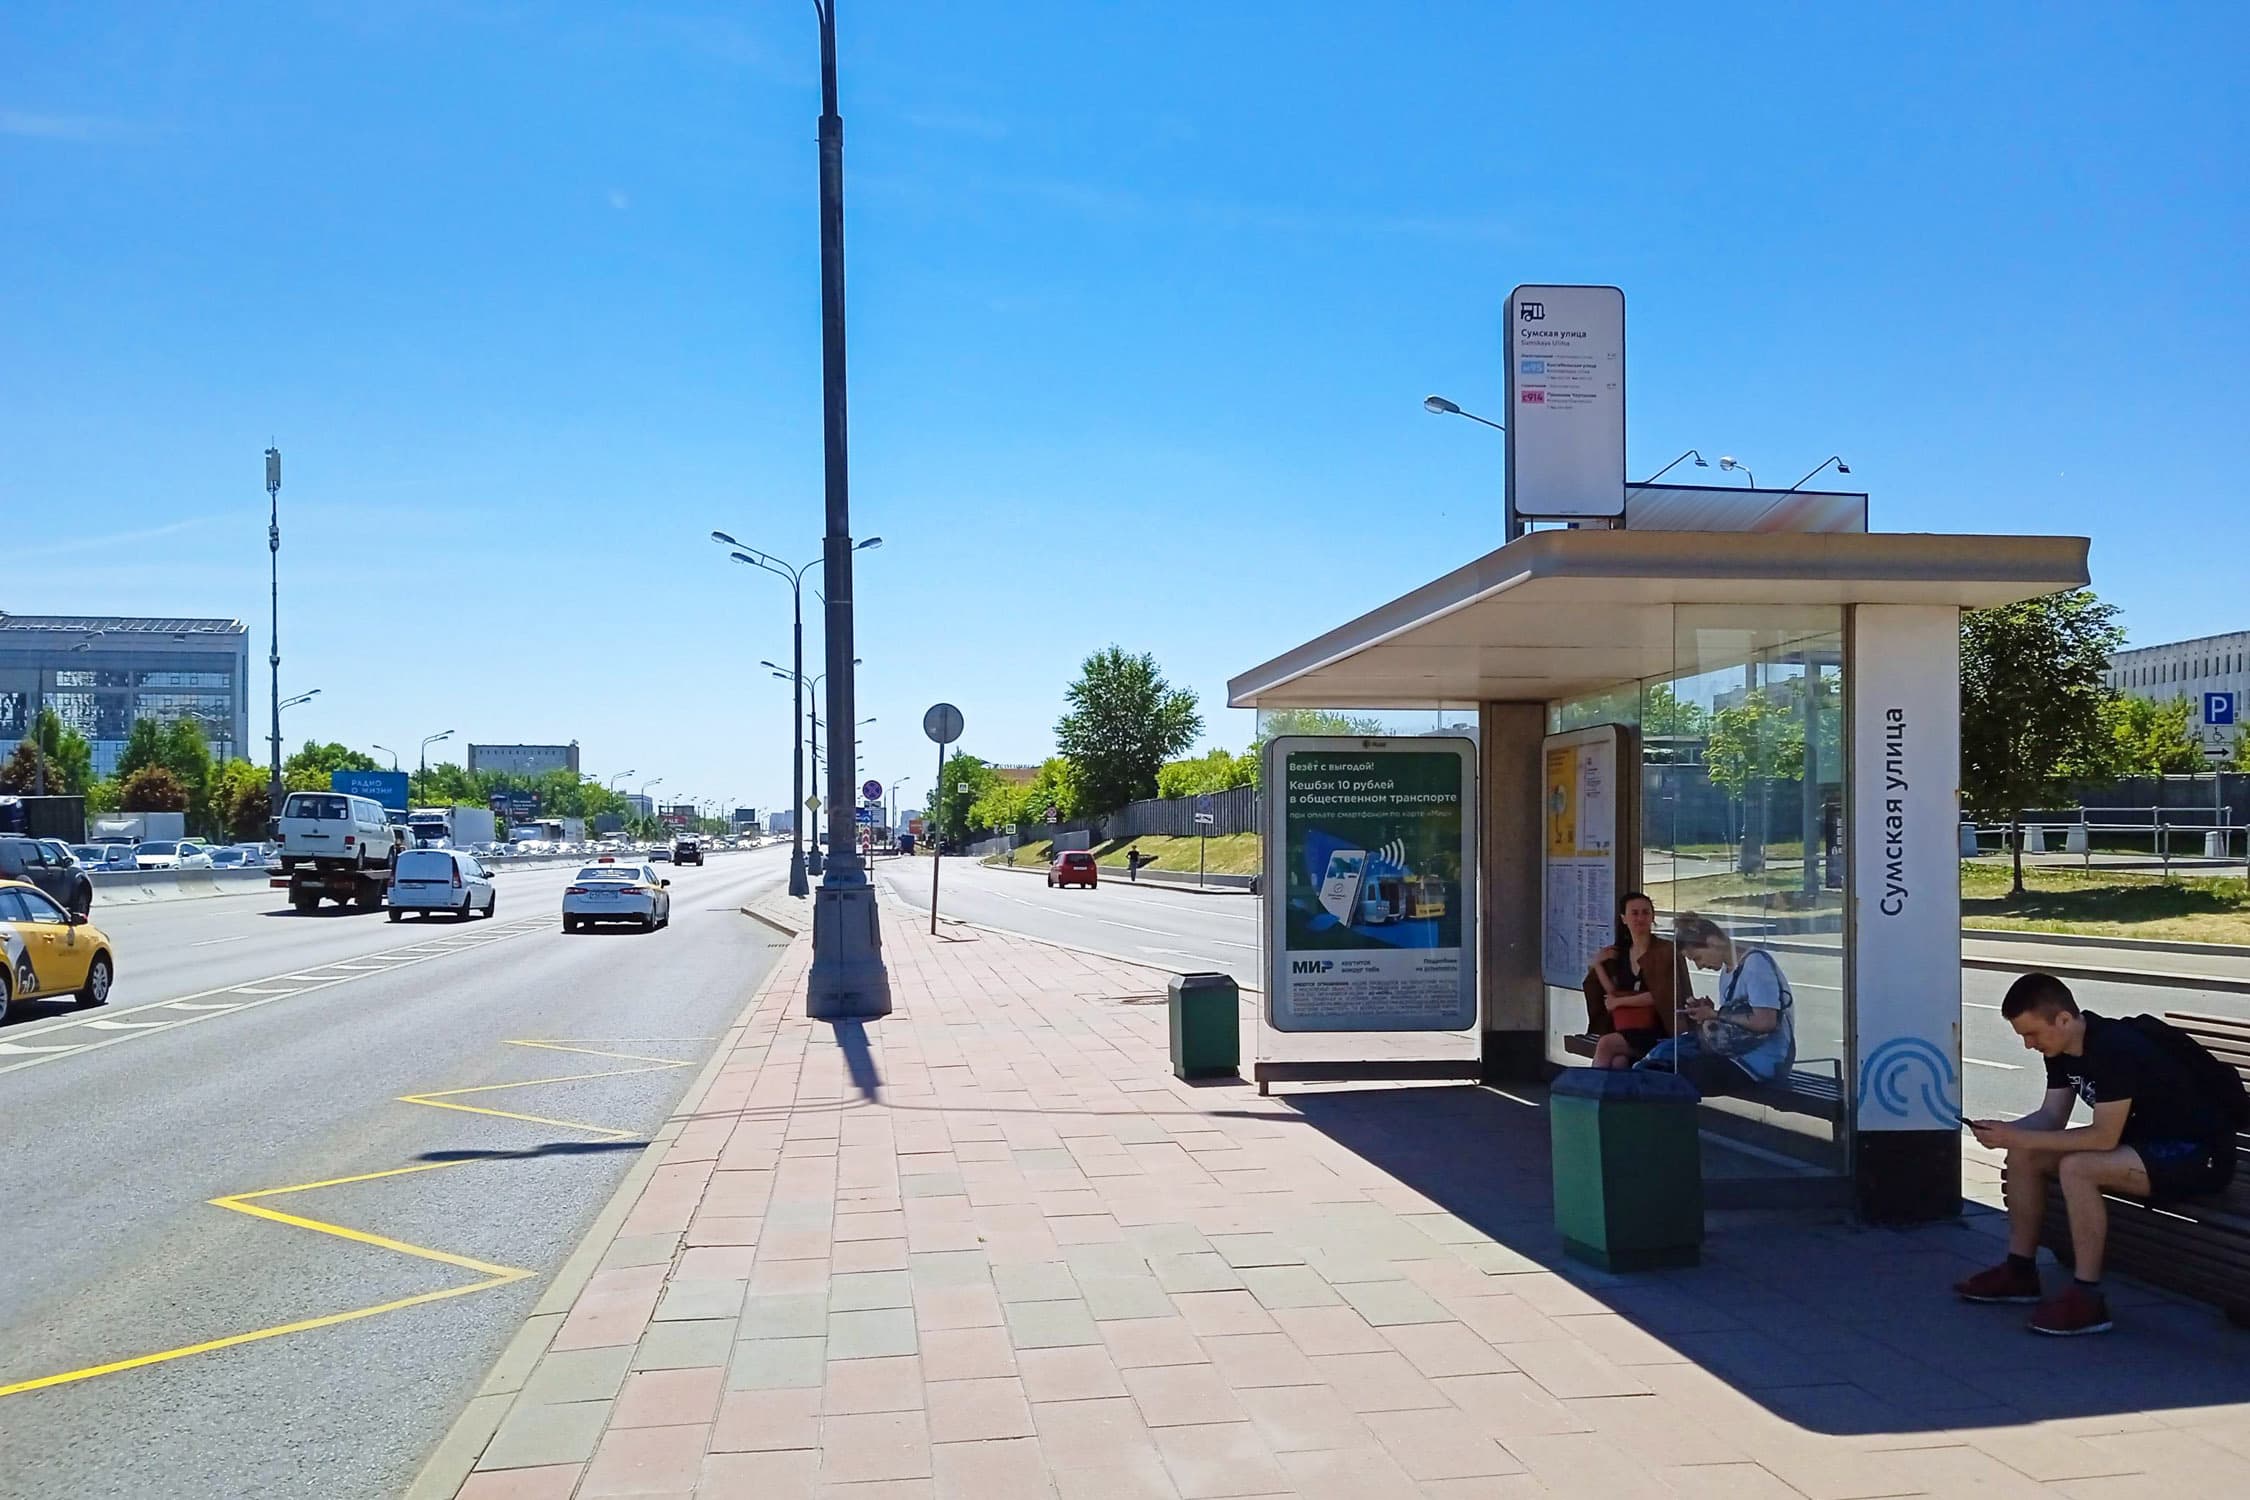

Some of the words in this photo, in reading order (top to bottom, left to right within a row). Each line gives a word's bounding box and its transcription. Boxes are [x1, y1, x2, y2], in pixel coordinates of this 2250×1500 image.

[1521, 328, 1558, 339] Сумская
[1561, 330, 1587, 340] улица
[2210, 697, 2228, 722] P
[1885, 707, 1909, 791] улица
[1289, 762, 1318, 772] Везёт
[1320, 764, 1327, 772] с
[1328, 761, 1375, 773] выгодой!
[351, 779, 382, 788] РАДИО
[1289, 781, 1335, 791] Кешбэк
[1338, 780, 1350, 791] 10
[1353, 779, 1394, 793] рублей
[1289, 796, 1296, 804] в
[1299, 794, 1387, 806] общественном
[1390, 793, 1457, 805] транспорте
[1880, 799, 1908, 917] Сумская
[1292, 960, 1334, 974] МИР
